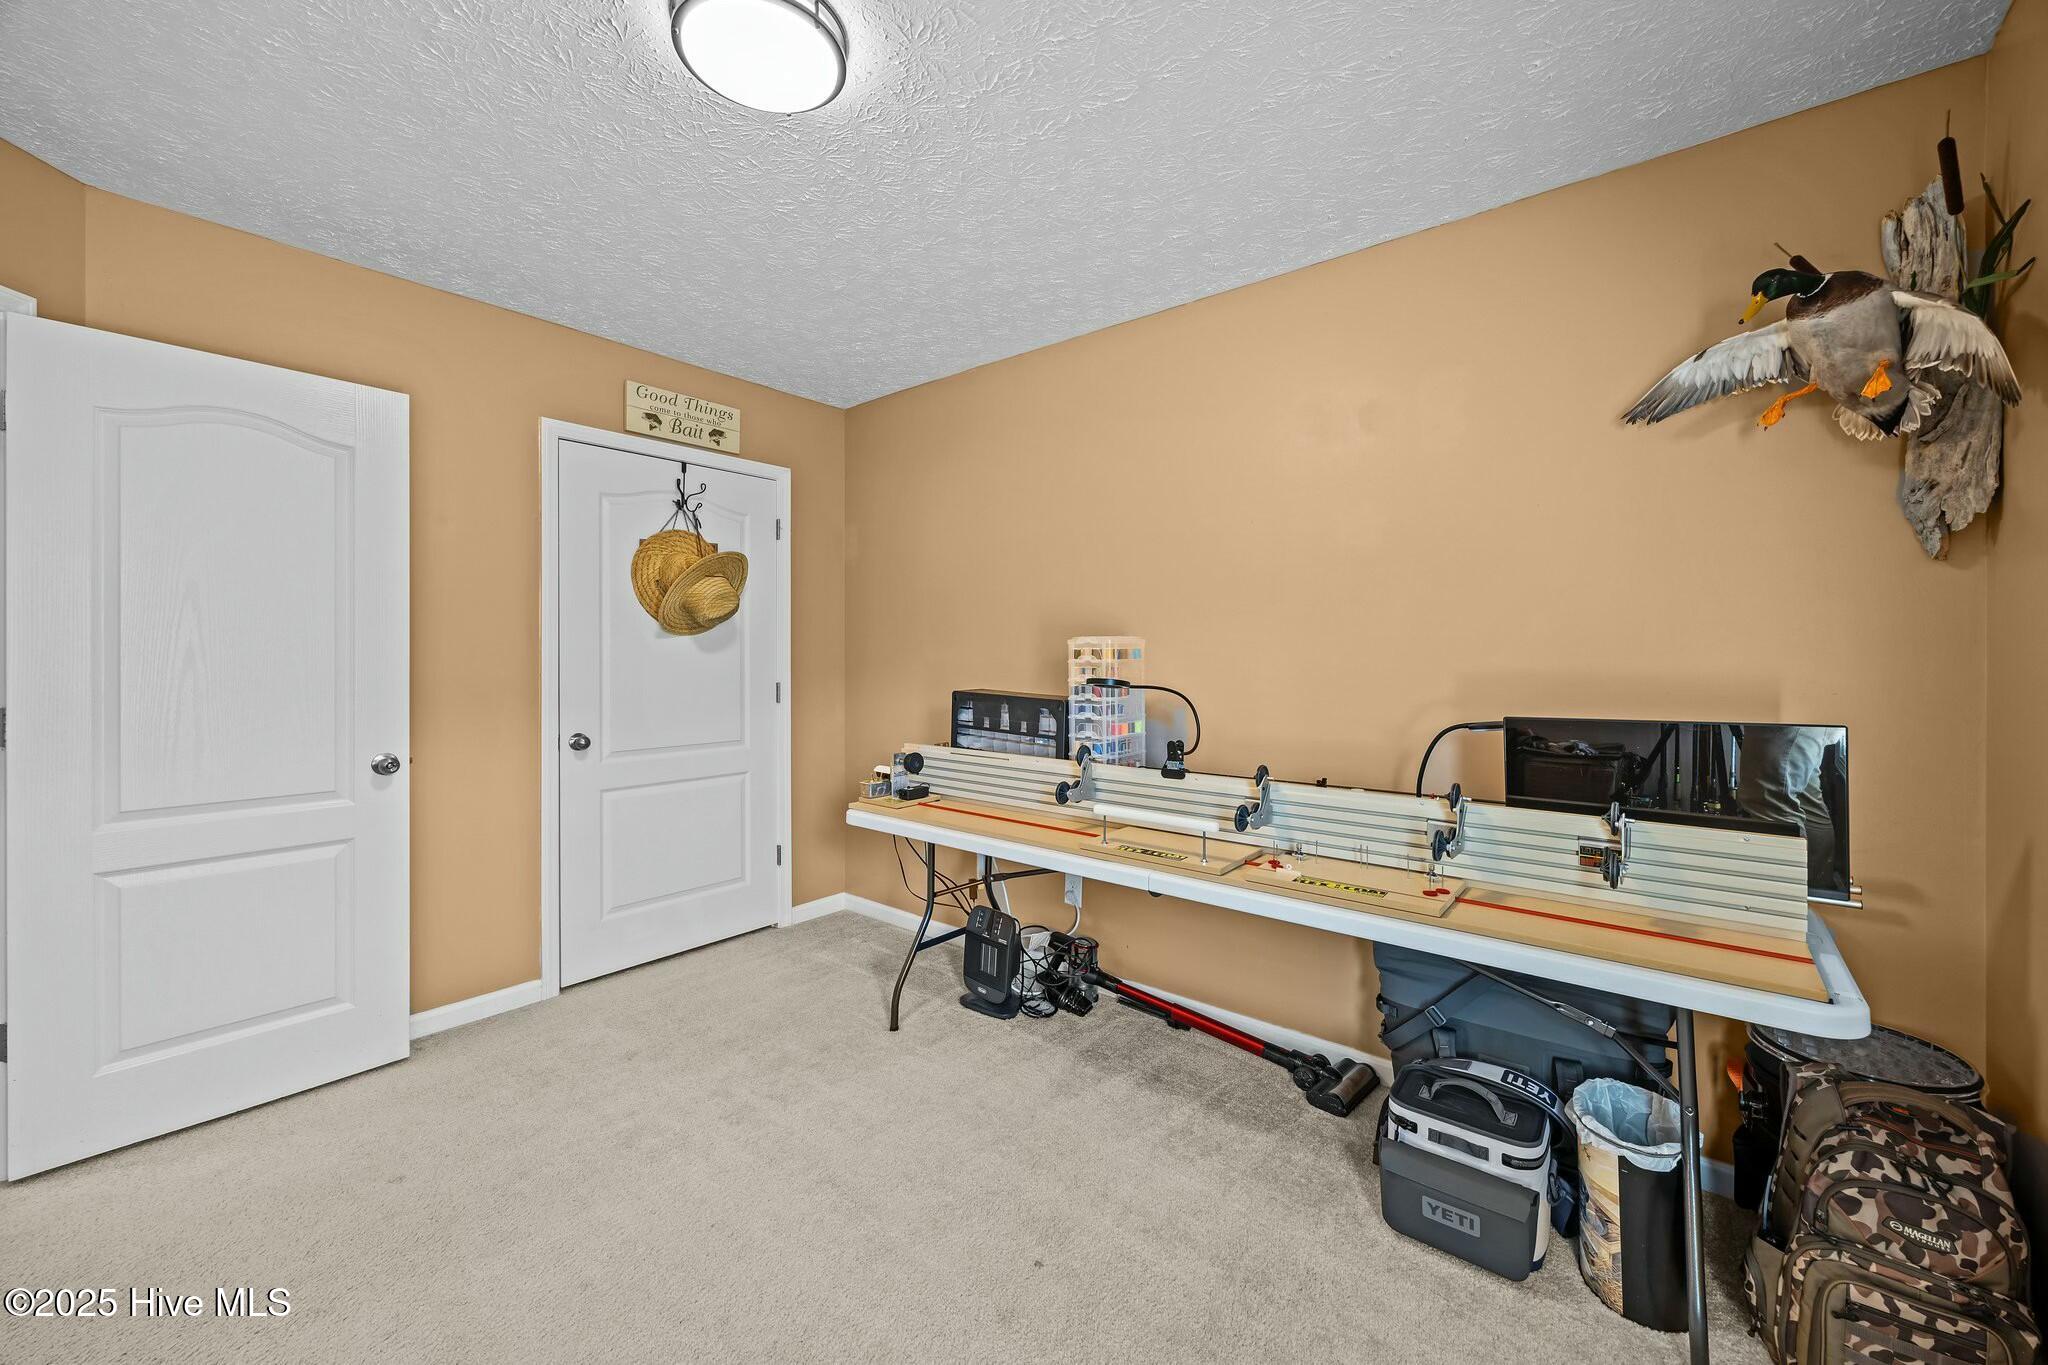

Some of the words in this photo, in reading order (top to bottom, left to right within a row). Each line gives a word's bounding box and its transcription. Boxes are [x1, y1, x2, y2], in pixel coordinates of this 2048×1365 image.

[636, 384, 678, 407] Good
[685, 397, 734, 423] Things
[649, 405, 671, 414] come
[684, 412, 704, 422] those
[707, 418, 722, 426] who
[670, 417, 704, 440] Bait
[1506, 1073, 1551, 1105] YETI
[1425, 1201, 1474, 1231] YETI
[1904, 1226, 1951, 1249] MAGELLAN
